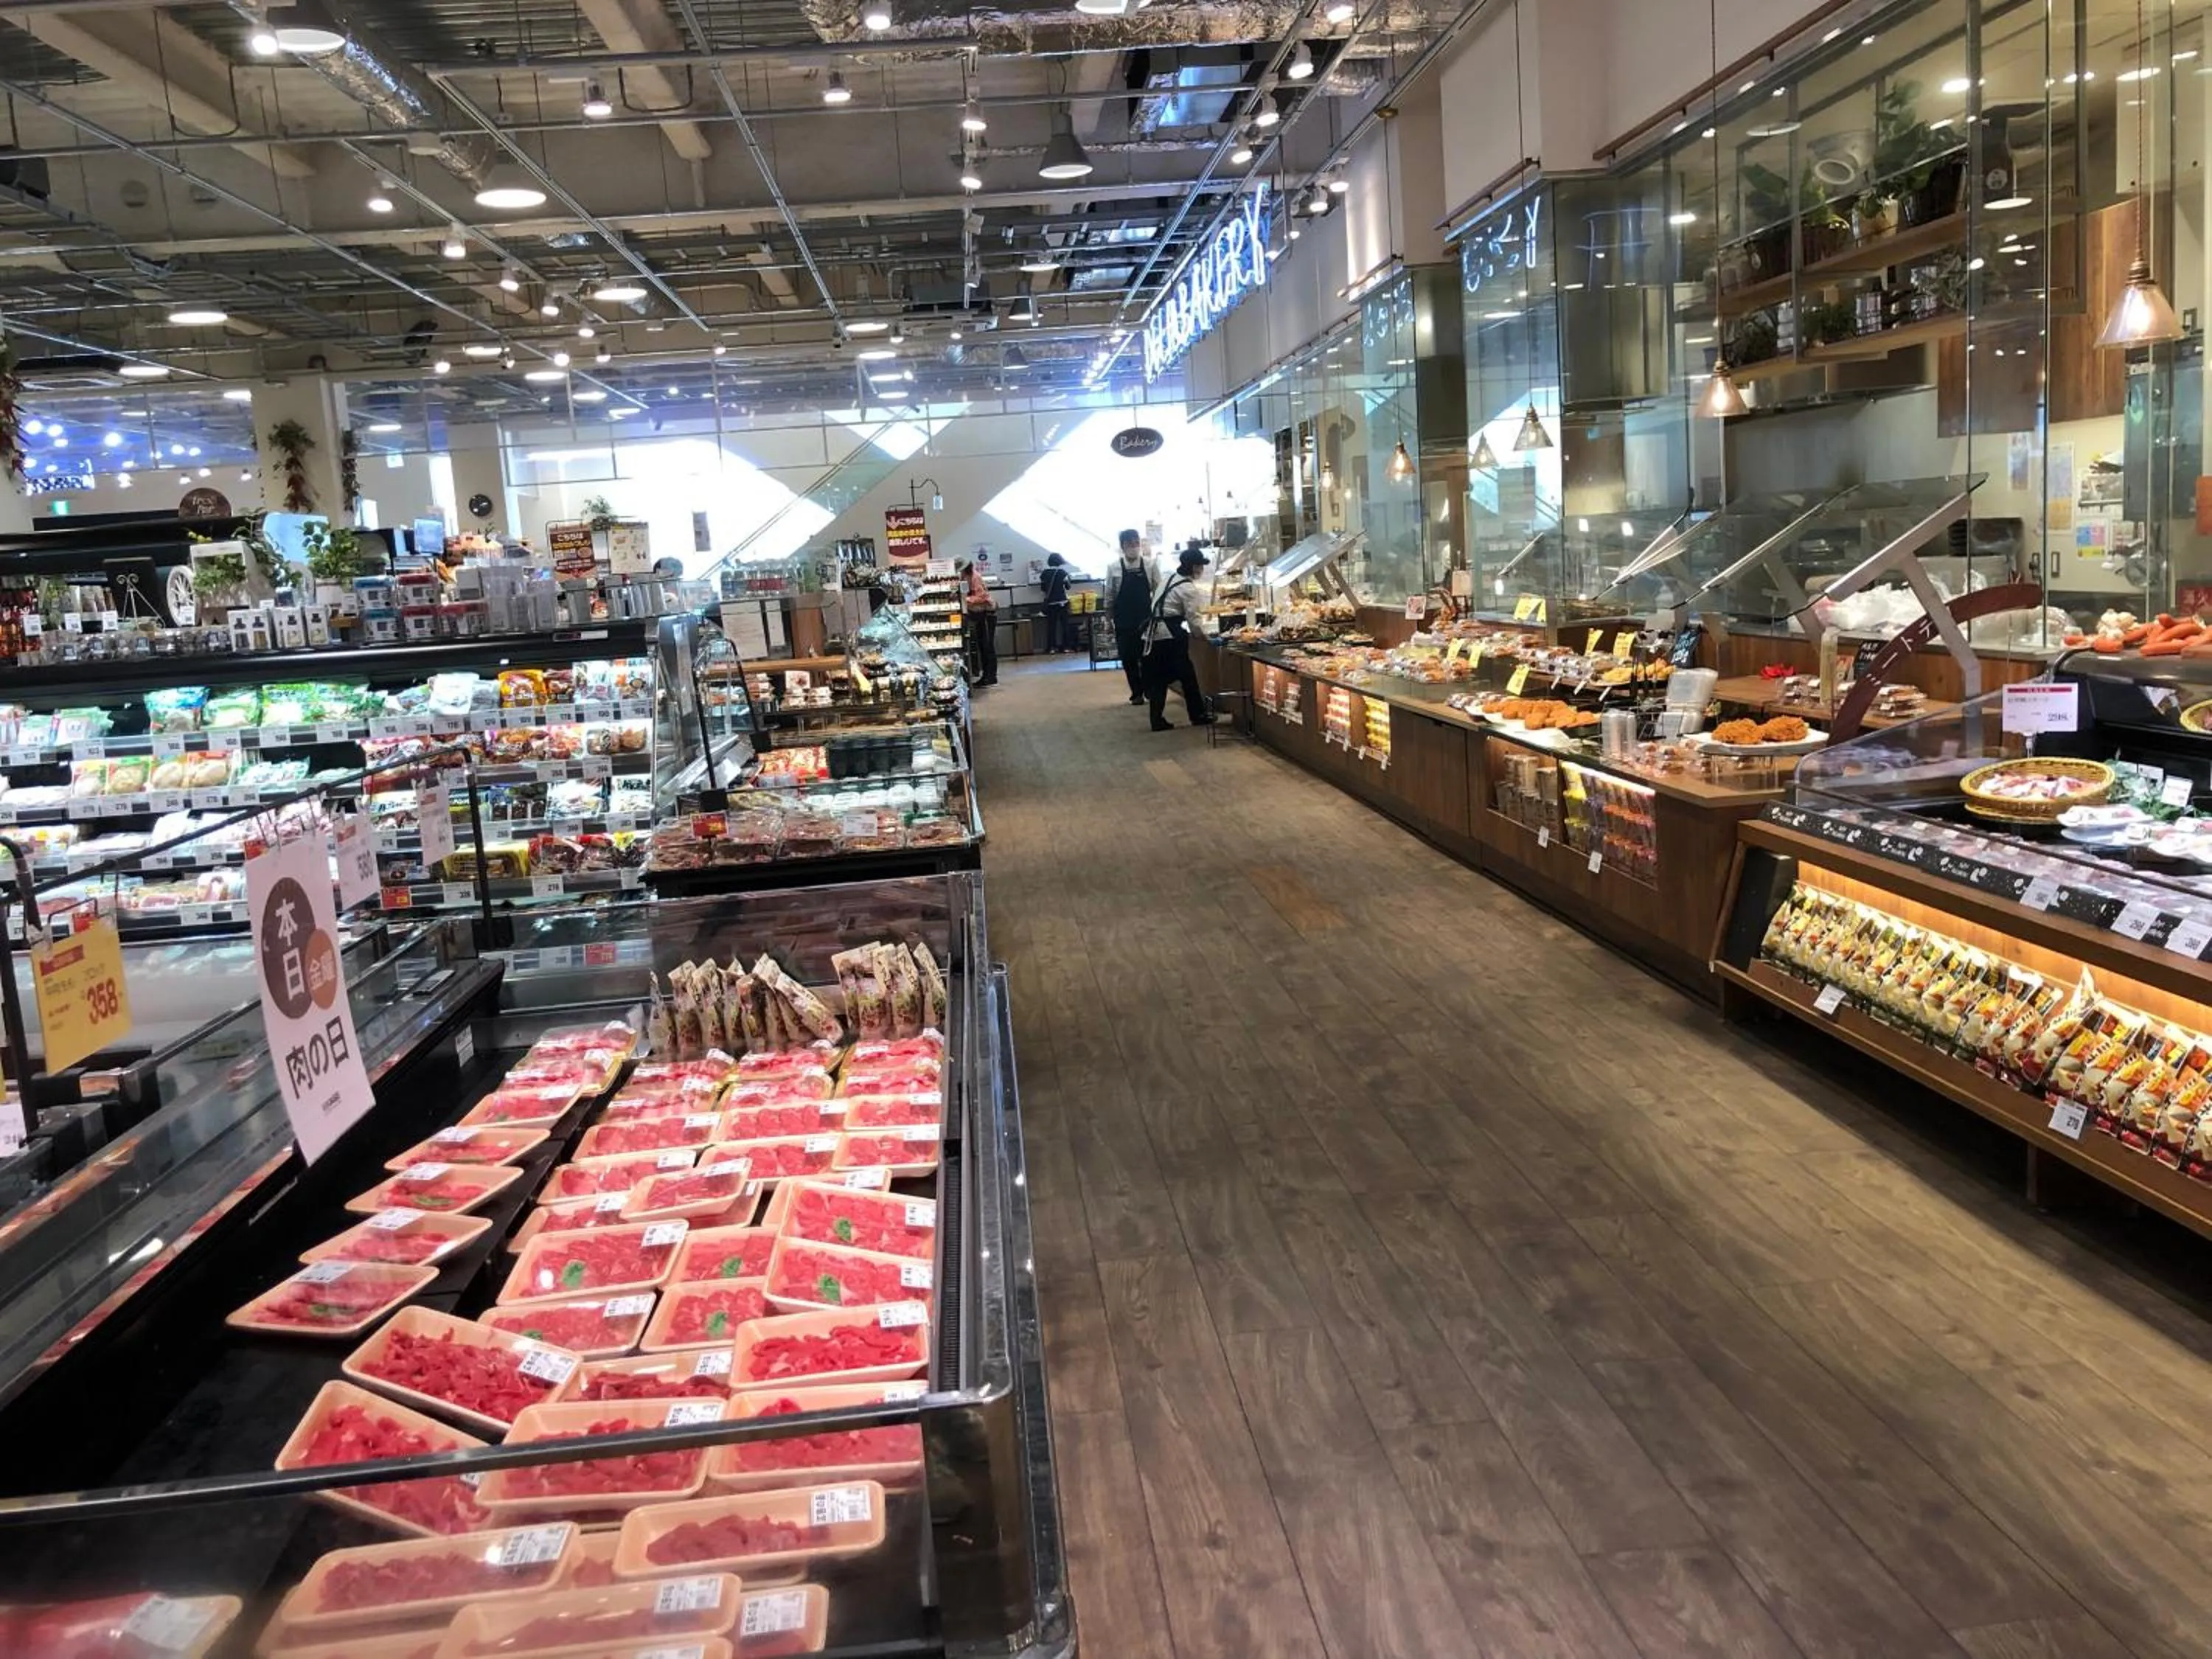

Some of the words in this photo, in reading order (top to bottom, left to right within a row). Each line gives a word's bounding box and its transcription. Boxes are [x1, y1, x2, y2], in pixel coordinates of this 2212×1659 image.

[1119, 434, 1157, 451] Bakery
[274, 897, 306, 1001] 本日
[87, 978, 119, 1025] 358
[286, 1015, 349, 1099] 肉の日
